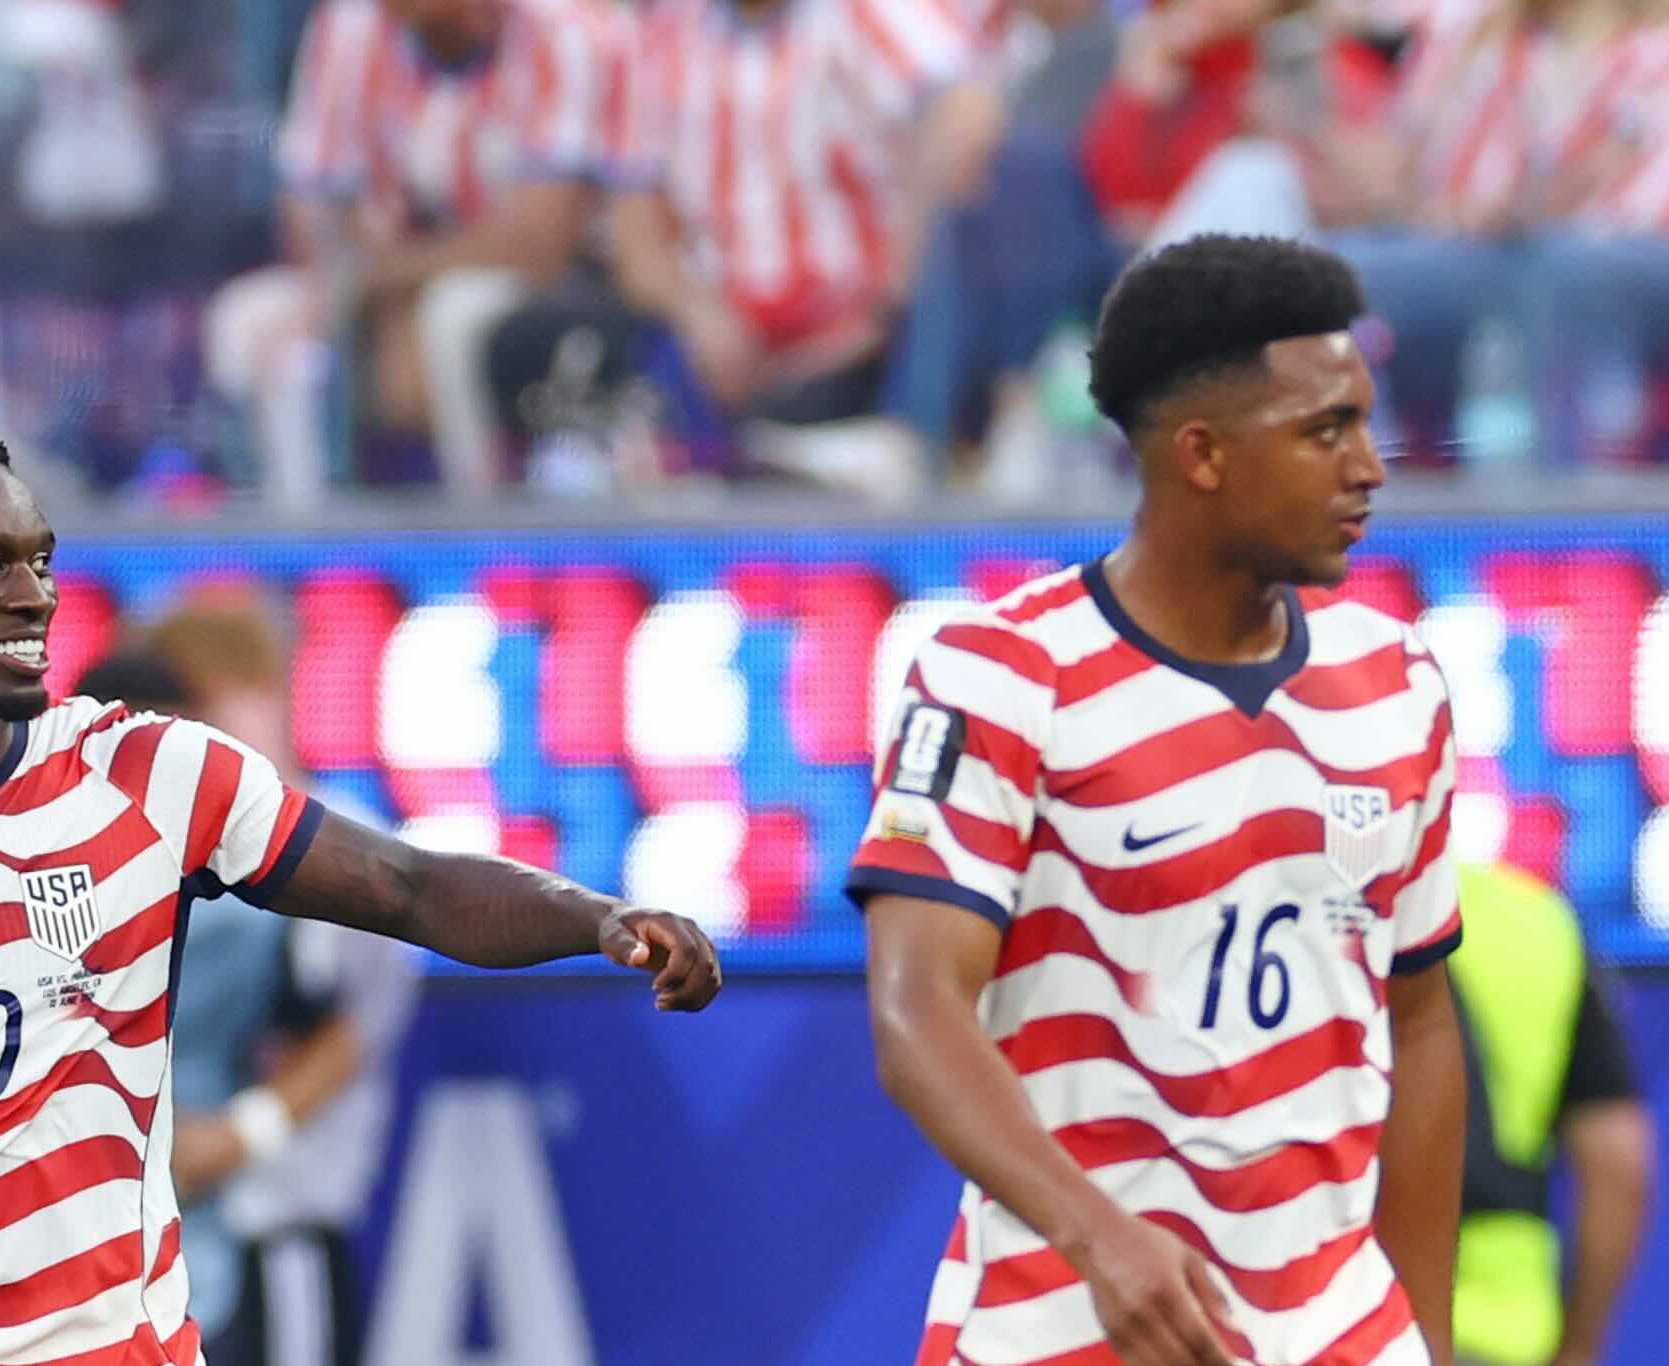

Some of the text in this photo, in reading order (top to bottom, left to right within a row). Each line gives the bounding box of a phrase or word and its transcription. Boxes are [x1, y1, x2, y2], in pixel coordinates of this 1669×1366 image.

[1330, 794, 1383, 829] USA
[26, 870, 88, 907] USA
[1199, 903, 1301, 1030] 16
